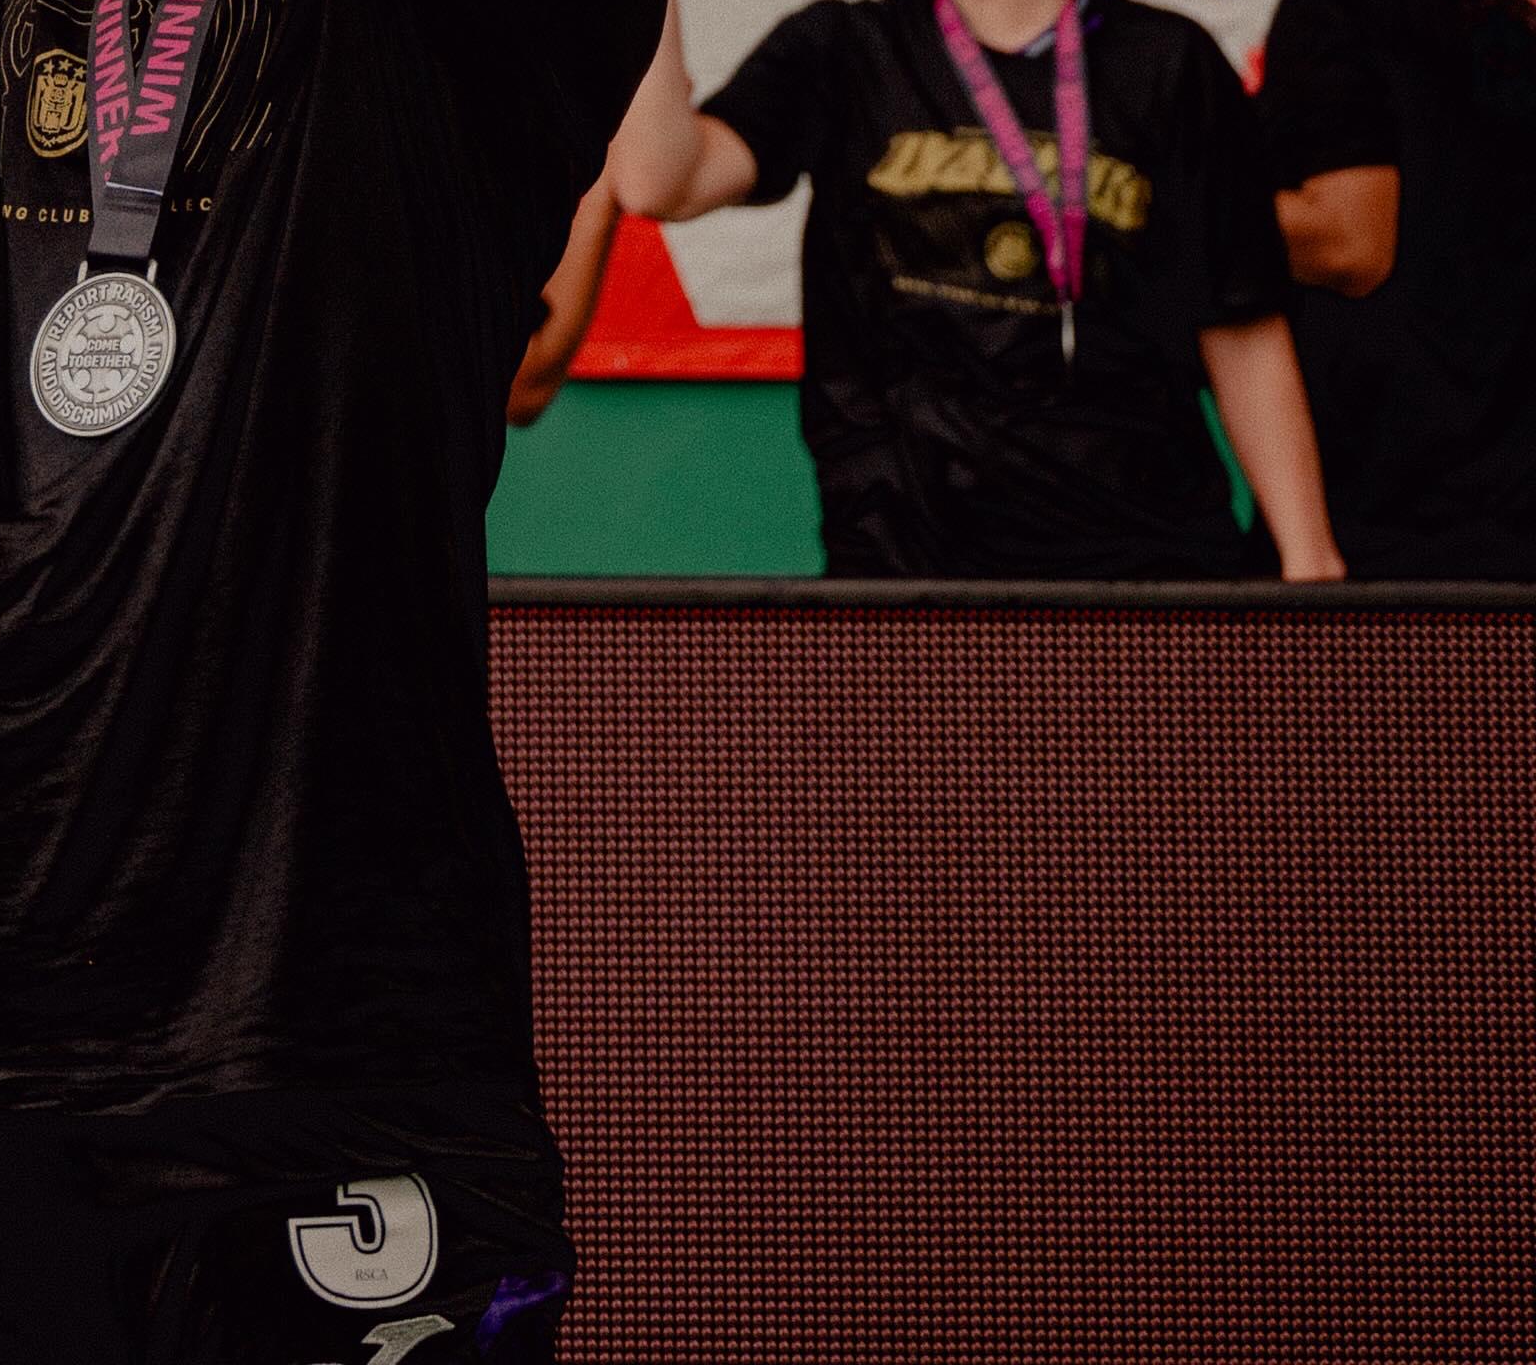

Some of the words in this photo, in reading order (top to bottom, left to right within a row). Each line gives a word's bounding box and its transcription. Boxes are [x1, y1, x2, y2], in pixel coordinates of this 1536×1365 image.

[38, 206, 91, 223] CLUB
[48, 283, 109, 342] REPORT
[110, 281, 162, 337] RACISM
[86, 338, 121, 353] COME
[67, 354, 133, 368] TOGETHER
[41, 347, 58, 393] AND
[49, 343, 162, 426] DISCRIMINATION
[355, 1269, 389, 1282] RSCA
